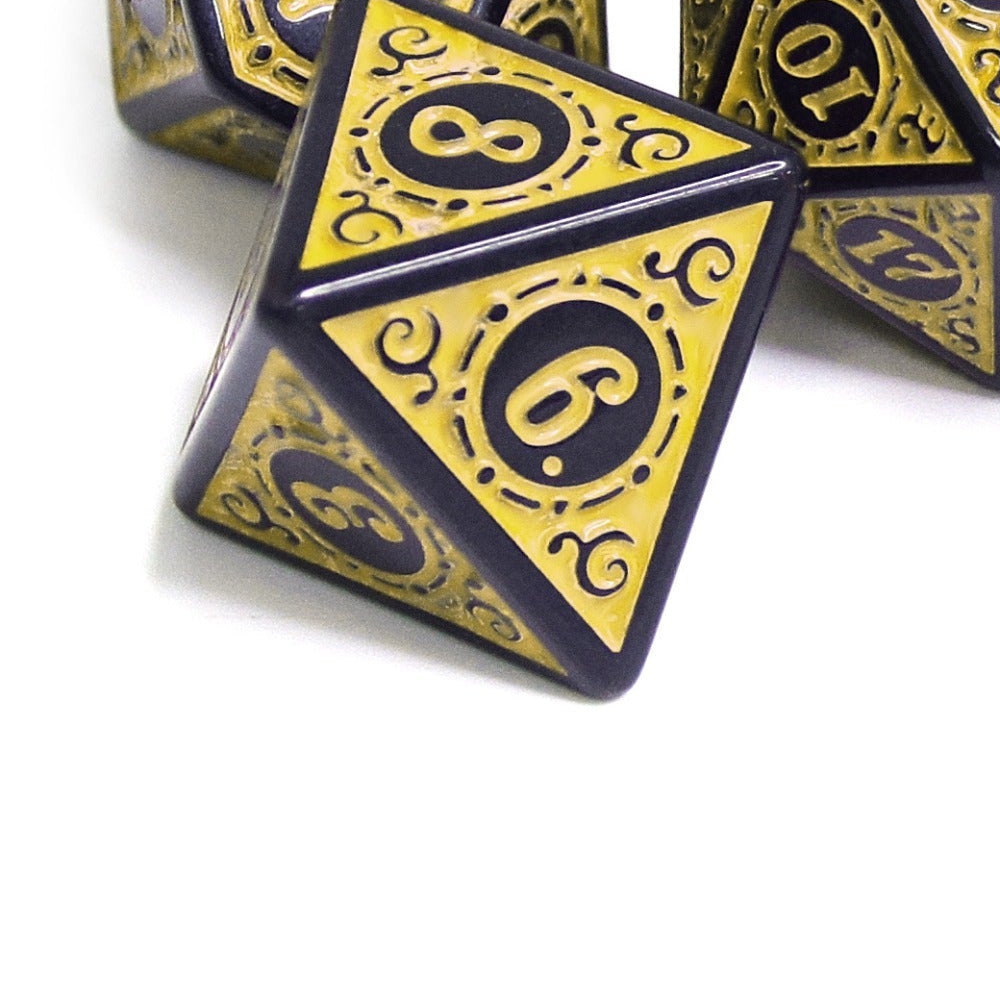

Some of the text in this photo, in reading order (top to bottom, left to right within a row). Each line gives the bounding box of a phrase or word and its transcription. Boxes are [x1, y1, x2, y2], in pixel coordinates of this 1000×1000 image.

[775, 23, 875, 123] 10
[409, 104, 542, 163] 8
[290, 481, 405, 543] 3
